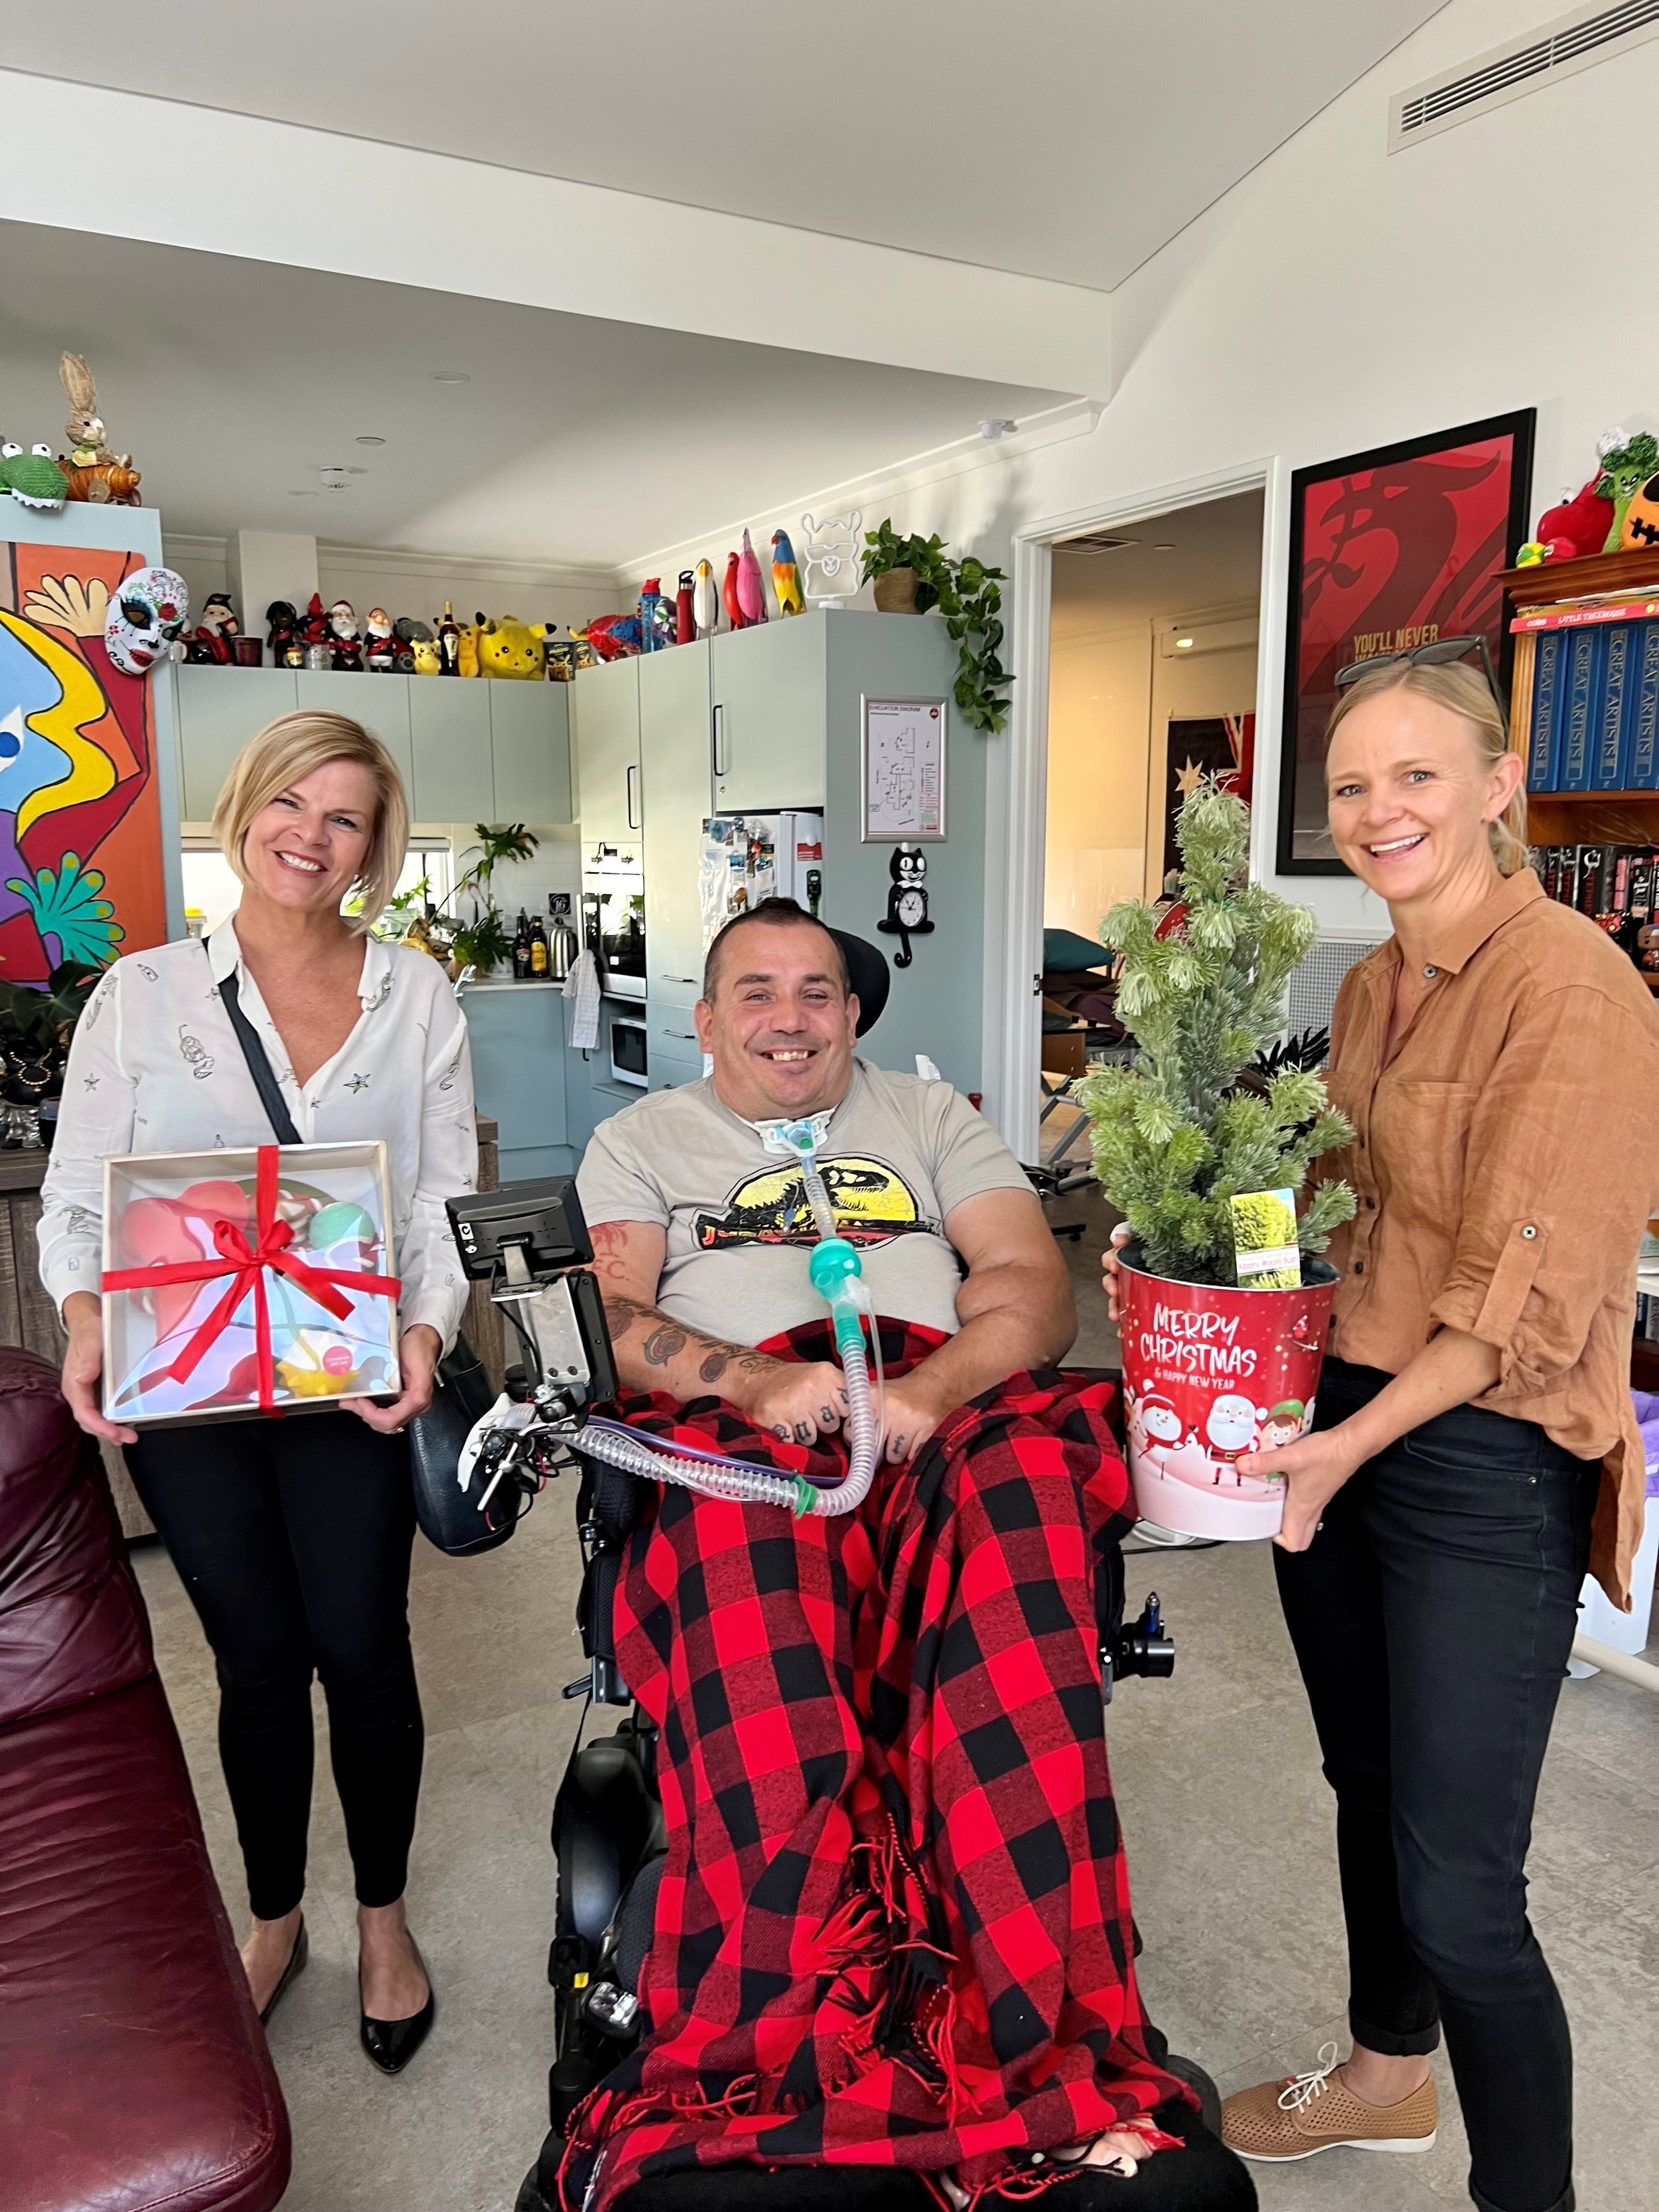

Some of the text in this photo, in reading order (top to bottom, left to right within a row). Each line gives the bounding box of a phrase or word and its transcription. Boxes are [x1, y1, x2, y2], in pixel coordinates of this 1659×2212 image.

[1354, 625, 1438, 654] YOU'LL NEVER
[1557, 613, 1582, 625] LITTLE
[1540, 643, 1555, 692] GREAT
[1575, 642, 1590, 692] GREAT
[1608, 639, 1624, 690] GREAT
[1644, 634, 1659, 686] GREAT
[1536, 701, 1550, 759] ARTISTS
[1571, 700, 1585, 759] ARTISTS
[1604, 696, 1621, 757] ARTISTS
[1638, 694, 1655, 757] ARTISTS
[1153, 1302, 1240, 1346] MERRY
[1141, 1333, 1257, 1377] CHRISTMAS
[1155, 1367, 1235, 1389] & HAPPY NEW YEAR
